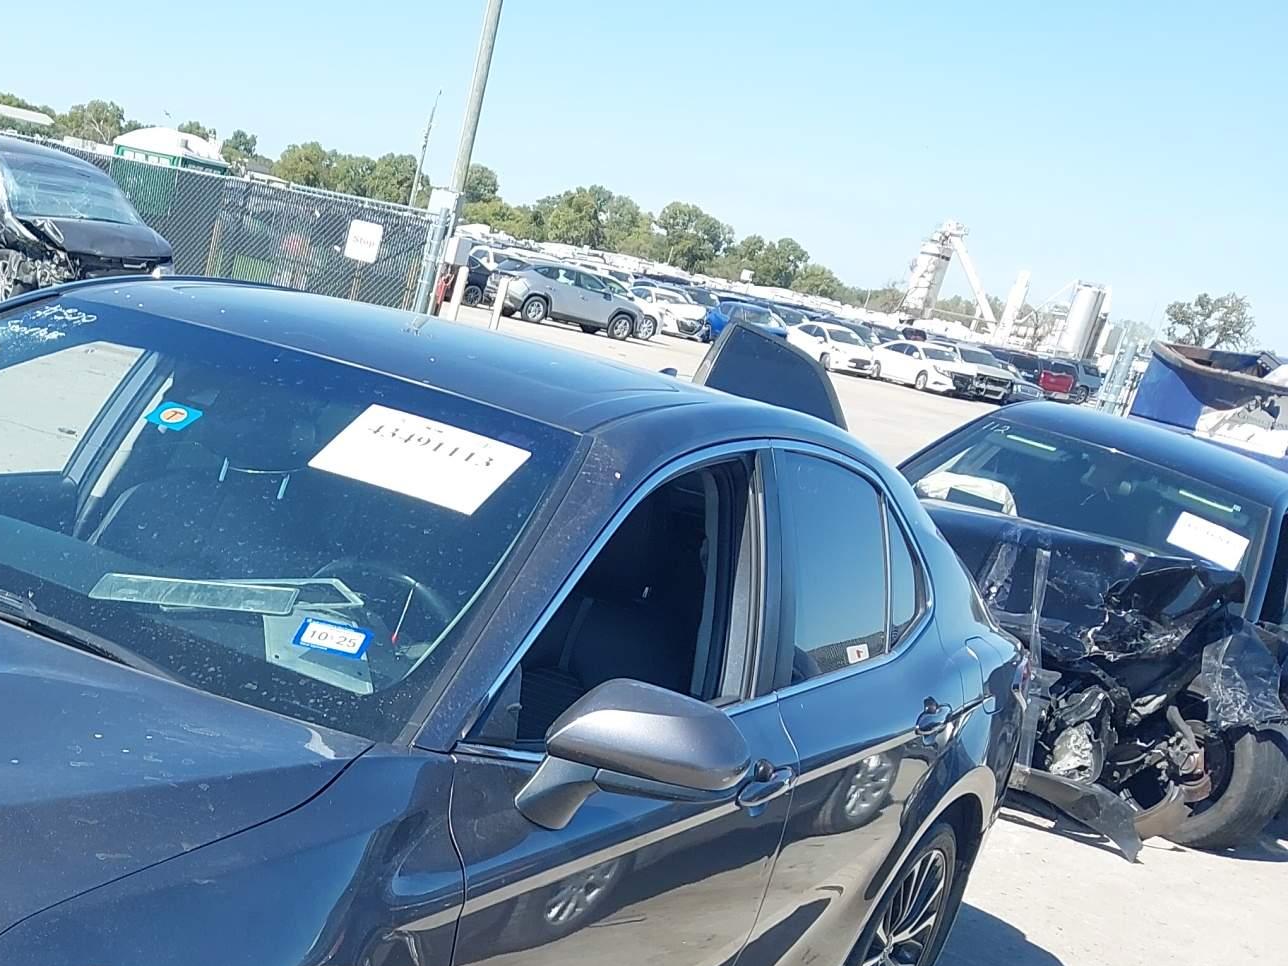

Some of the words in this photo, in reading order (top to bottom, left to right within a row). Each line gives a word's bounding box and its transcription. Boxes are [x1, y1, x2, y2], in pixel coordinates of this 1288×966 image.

[367, 425, 494, 467] 43491113
[310, 629, 329, 641] 10
[335, 635, 357, 648] 25
